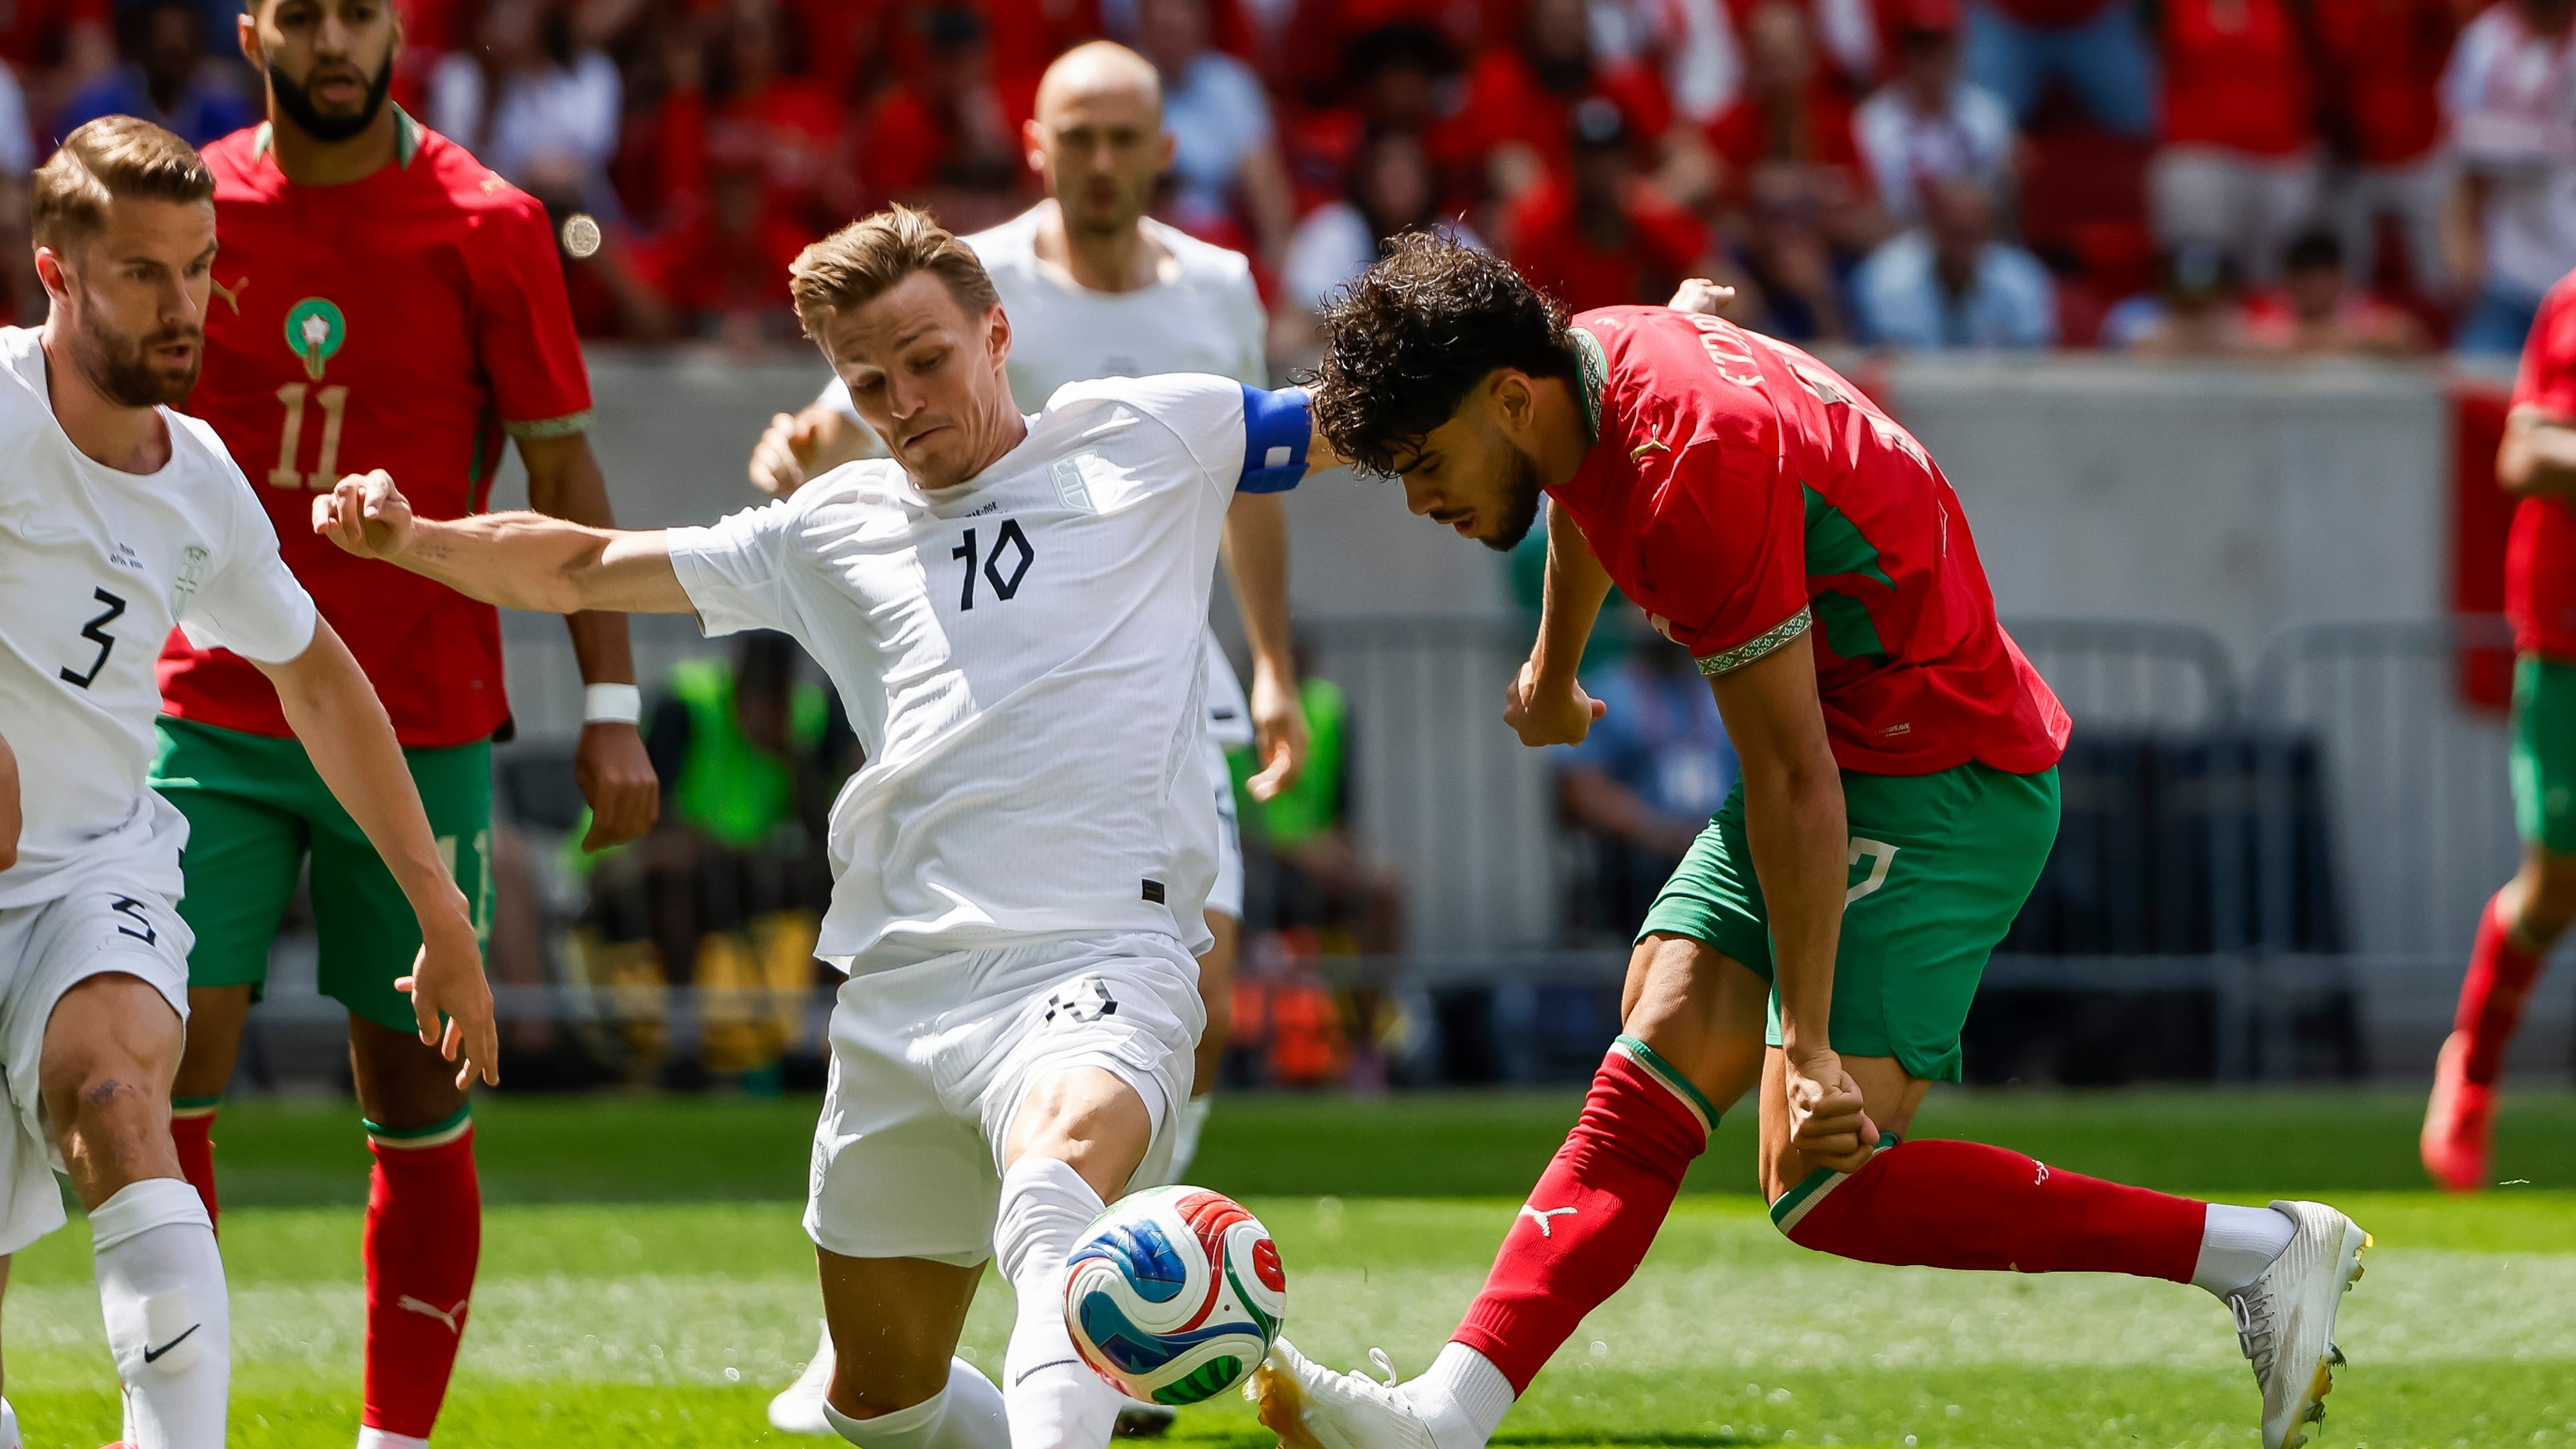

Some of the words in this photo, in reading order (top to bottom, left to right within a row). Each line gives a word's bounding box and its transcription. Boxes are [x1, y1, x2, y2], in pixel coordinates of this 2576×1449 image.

[268, 381, 350, 491] 11
[952, 518, 1034, 611] 10
[60, 586, 126, 690] 3
